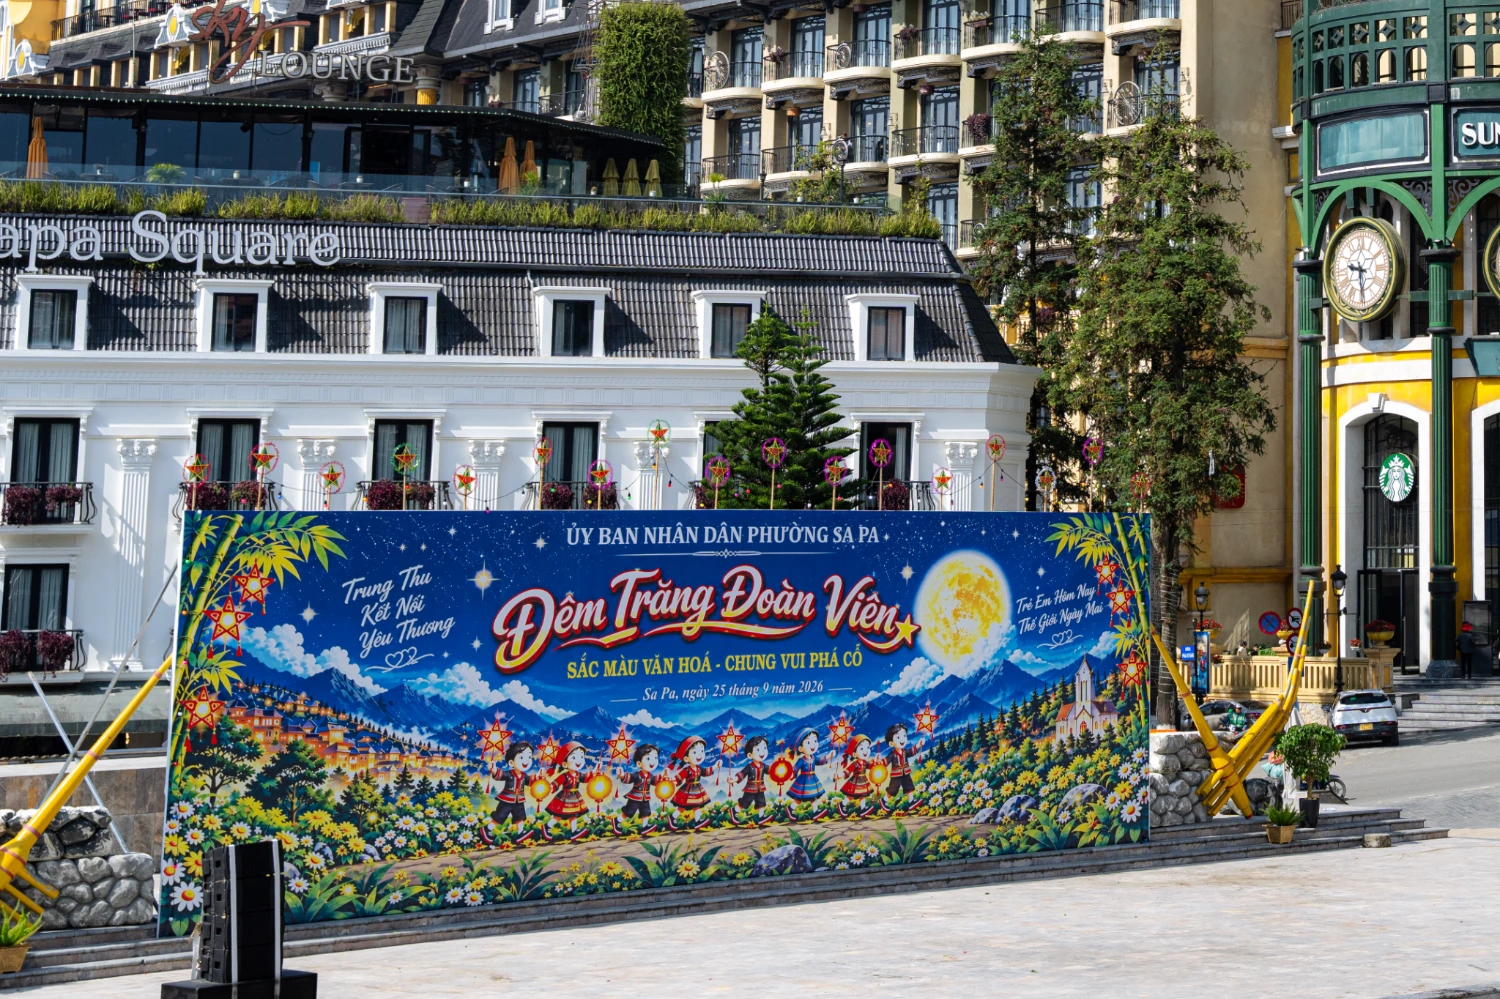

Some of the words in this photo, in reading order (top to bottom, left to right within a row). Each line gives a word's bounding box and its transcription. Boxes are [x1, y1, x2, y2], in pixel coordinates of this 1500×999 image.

[257, 50, 414, 83] LOUNGE
[128, 210, 341, 276] Square
[566, 522, 594, 545] ỦY
[598, 527, 639, 545] BAN
[643, 521, 699, 544] NHÂN
[703, 521, 743, 544] DÂN
[747, 521, 829, 543] PHƯỜNG
[832, 525, 854, 543] SA
[858, 525, 880, 543] PA
[342, 577, 394, 604] Trung
[399, 564, 432, 591] Thu
[1016, 597, 1034, 614] Trẻ
[1035, 593, 1053, 610] Em
[1054, 588, 1076, 605] Hôm
[1077, 583, 1097, 601] Nay
[361, 602, 391, 627] Kết
[395, 594, 425, 620] Nối
[493, 588, 608, 673] Đêm
[610, 567, 716, 640] Trăng
[720, 564, 816, 622] Đoàn
[823, 574, 900, 637] Viên
[1018, 616, 1037, 635] Thế
[1038, 613, 1058, 634] Giới
[1060, 607, 1084, 627] Ngày
[1085, 600, 1104, 618] Mai
[359, 628, 393, 659] Yêu
[396, 616, 456, 643] Thương
[567, 652, 599, 679] SẮC
[603, 655, 639, 677] MÀU
[642, 654, 674, 675] VĂN
[678, 651, 712, 673] HOÁ
[725, 653, 776, 672] CHUNG
[781, 652, 806, 670] VUI
[809, 647, 839, 668] PHÁ
[843, 643, 863, 667] CỖ
[642, 687, 657, 701] Sa
[661, 687, 679, 700] Pa,
[682, 686, 710, 702] ngày
[712, 684, 726, 697] 25
[728, 683, 760, 698] tháng
[762, 682, 770, 694] 9
[772, 682, 795, 695] năm
[798, 680, 824, 694] 2026
